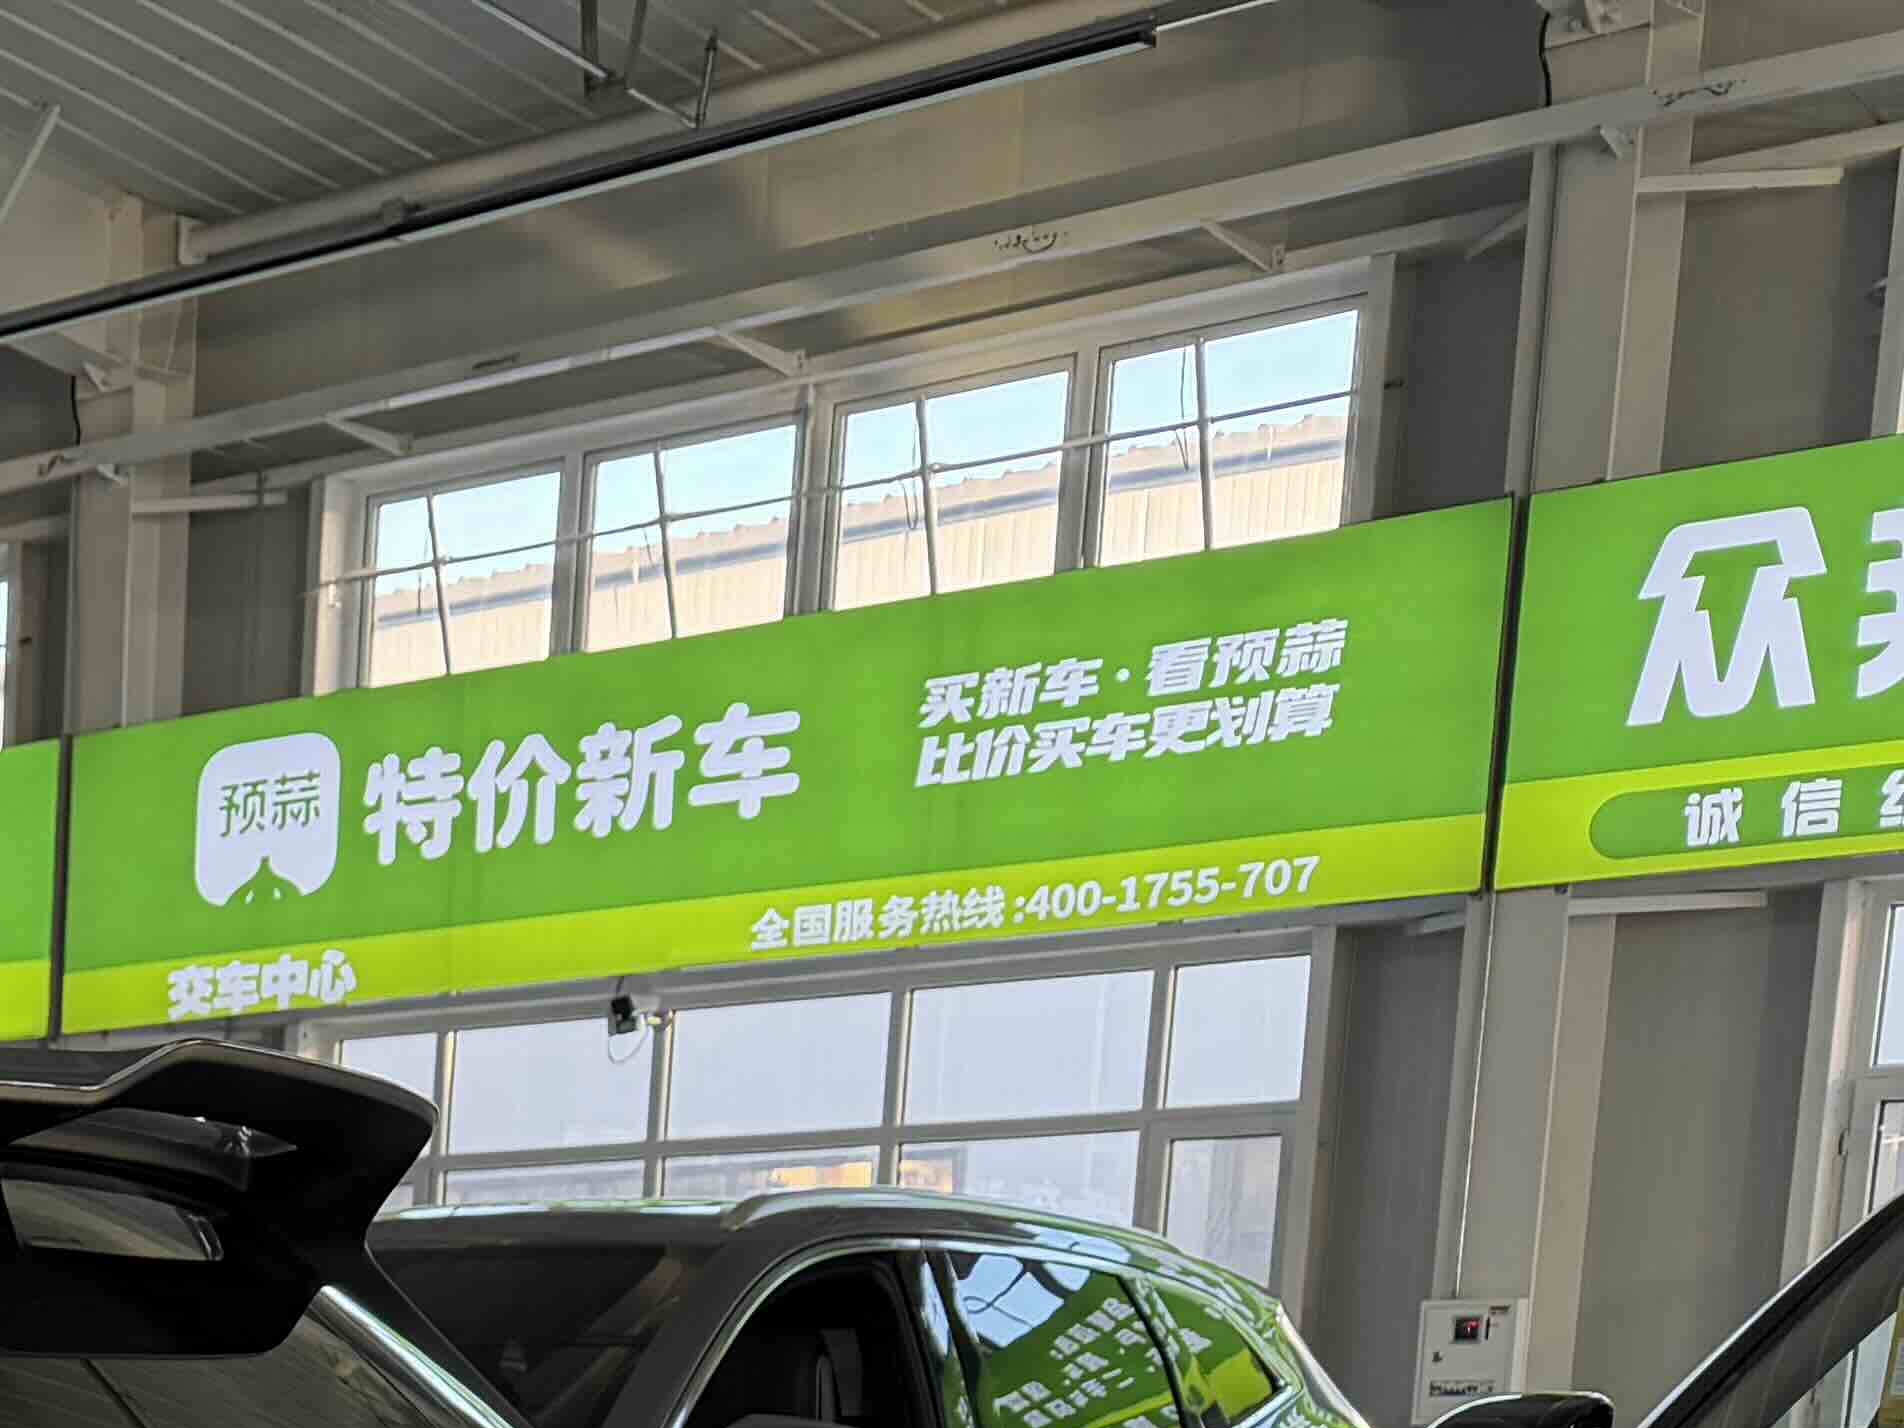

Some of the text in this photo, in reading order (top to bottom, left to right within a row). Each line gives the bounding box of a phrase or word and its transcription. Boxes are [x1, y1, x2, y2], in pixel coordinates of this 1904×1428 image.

[1626, 506, 1904, 727] 众
[362, 702, 800, 866] 特价新车
[915, 682, 1341, 787] 比价买车更划算
[218, 771, 321, 838] 预蒜
[167, 949, 357, 1022] 交车中心
